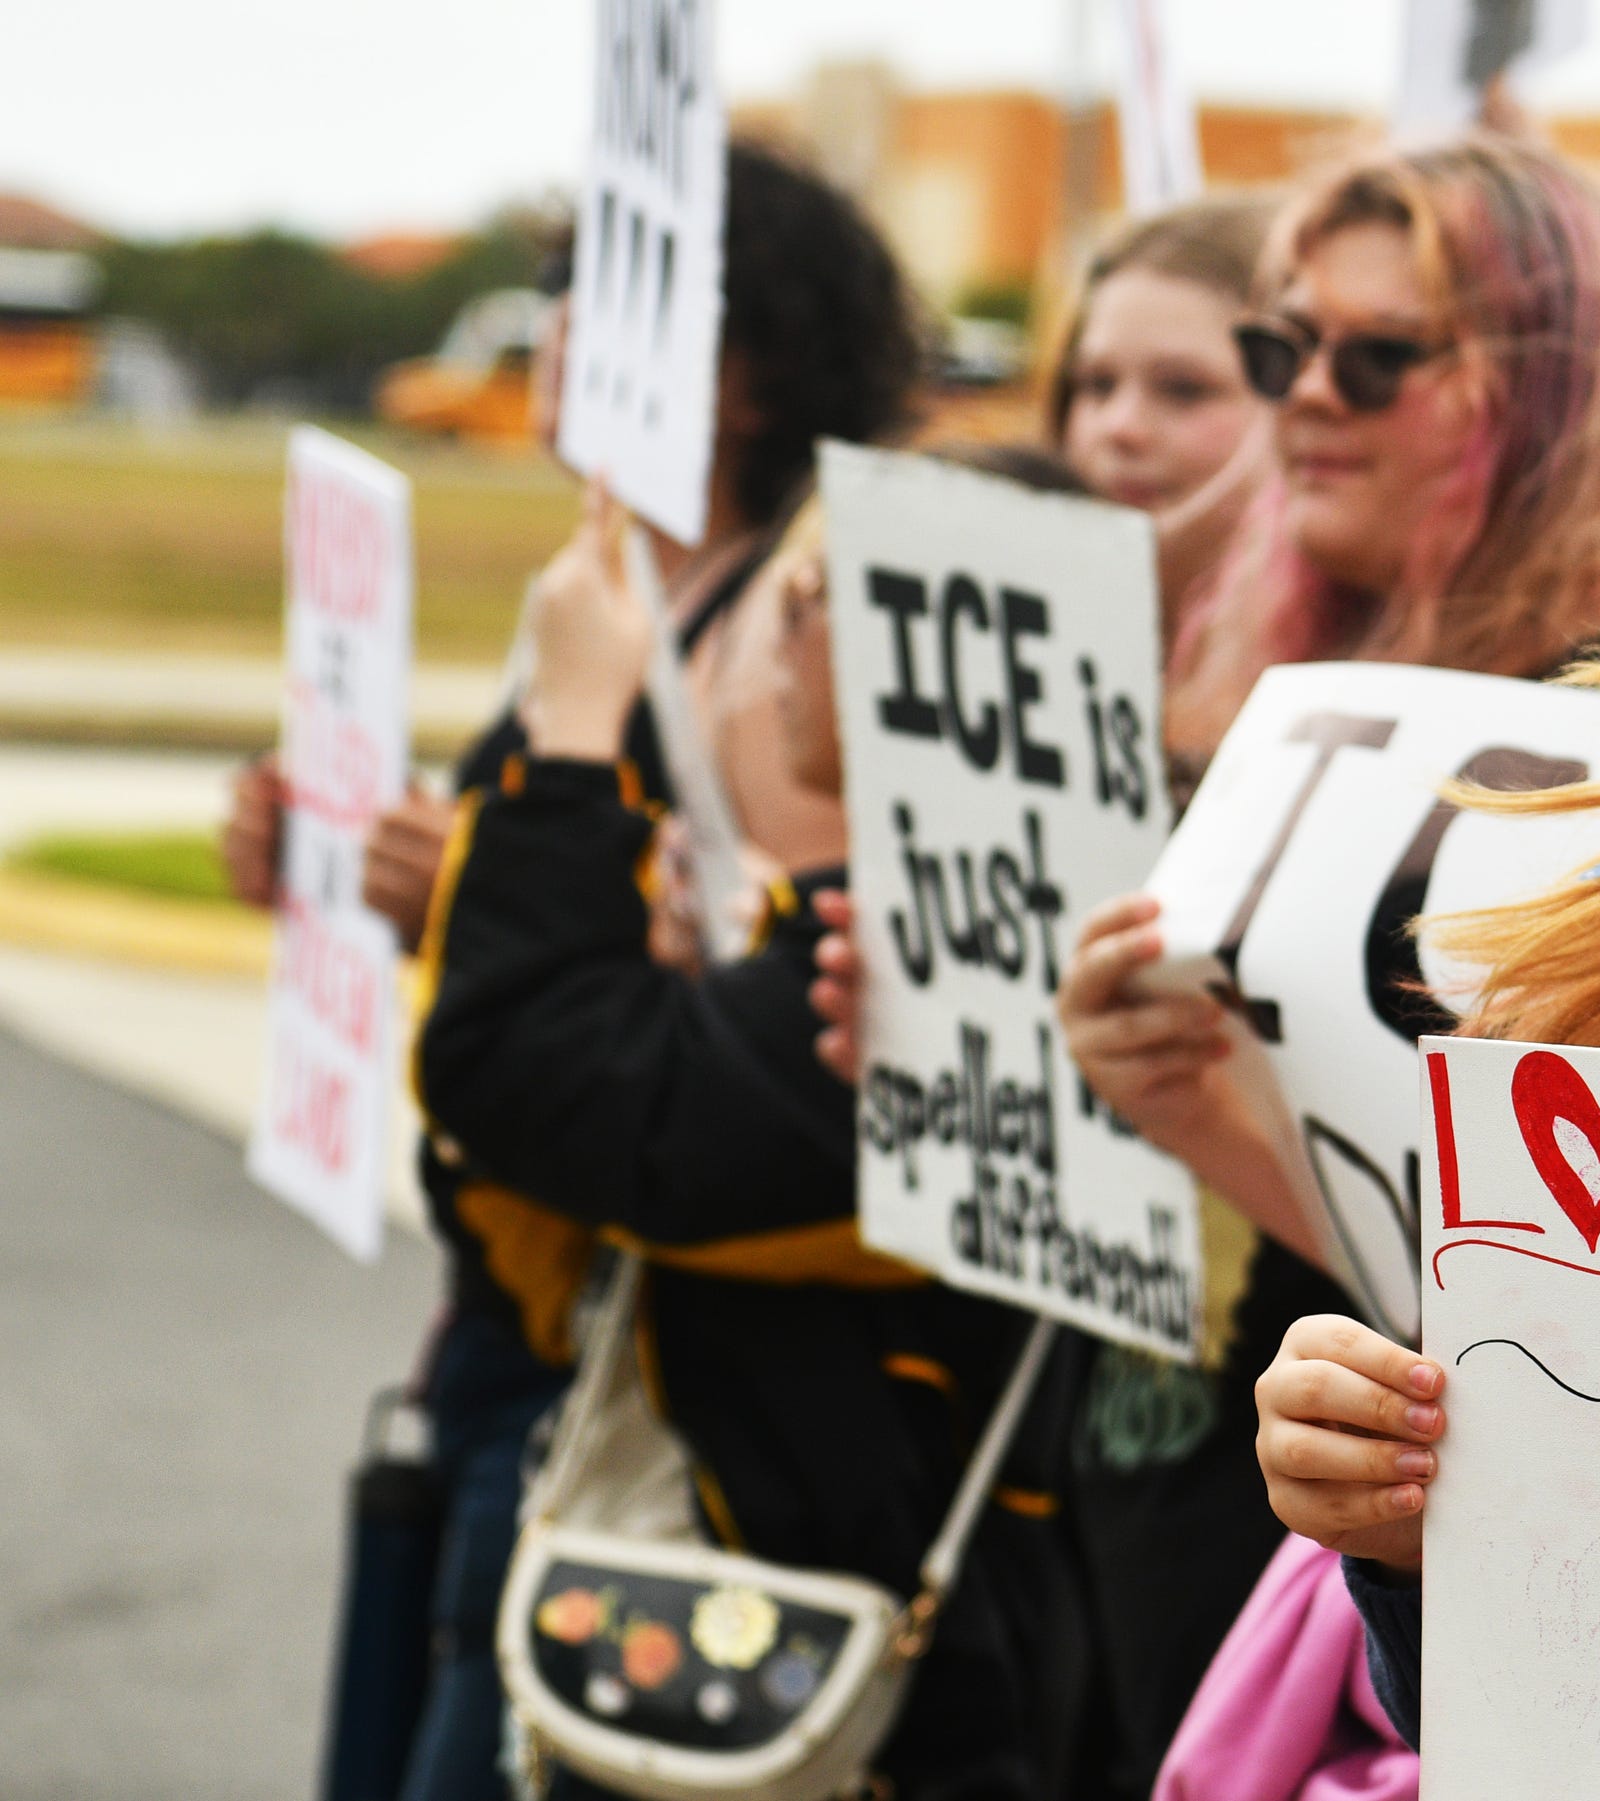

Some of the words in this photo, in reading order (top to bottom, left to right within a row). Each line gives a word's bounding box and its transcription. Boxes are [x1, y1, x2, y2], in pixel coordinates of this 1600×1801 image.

[864, 566, 1065, 788] ICE
[1079, 657, 1147, 819] is
[889, 803, 1063, 993] just
[862, 1020, 1057, 1190] spelled
